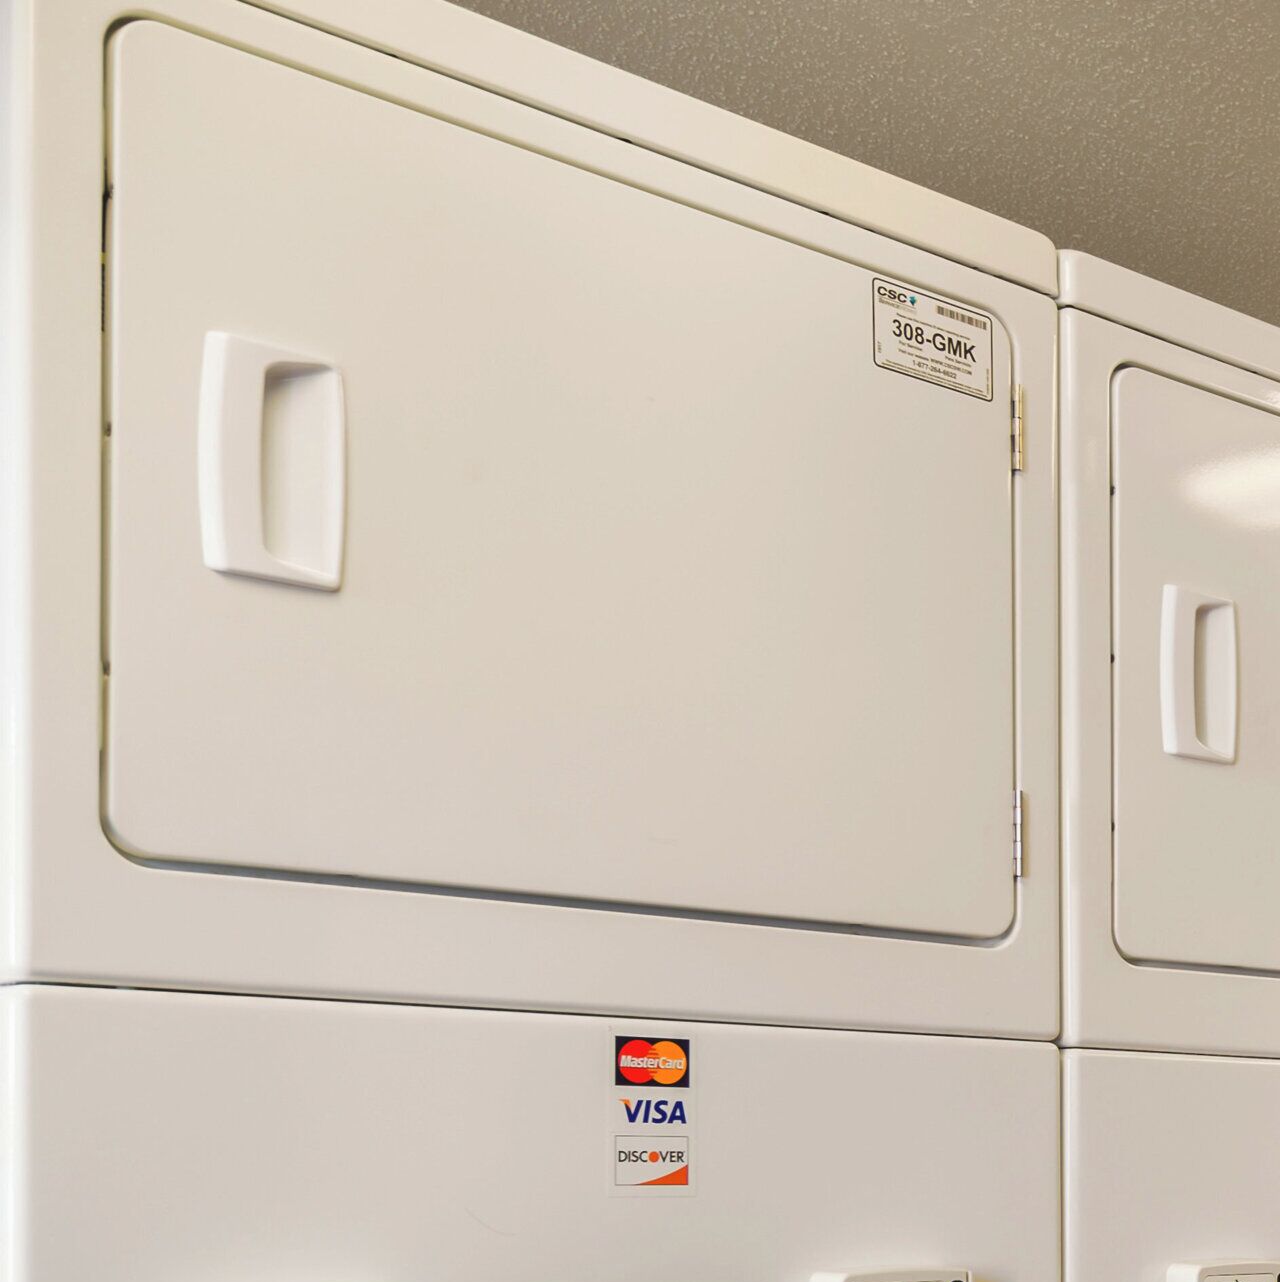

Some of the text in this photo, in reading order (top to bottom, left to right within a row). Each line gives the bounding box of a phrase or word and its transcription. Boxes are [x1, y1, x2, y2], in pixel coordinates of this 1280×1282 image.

[877, 286, 907, 304] CSC
[892, 319, 977, 363] 308-GMK
[620, 1055, 685, 1070] MasterCard
[619, 1098, 687, 1124] VISA
[618, 1150, 684, 1163] DISCOVER
